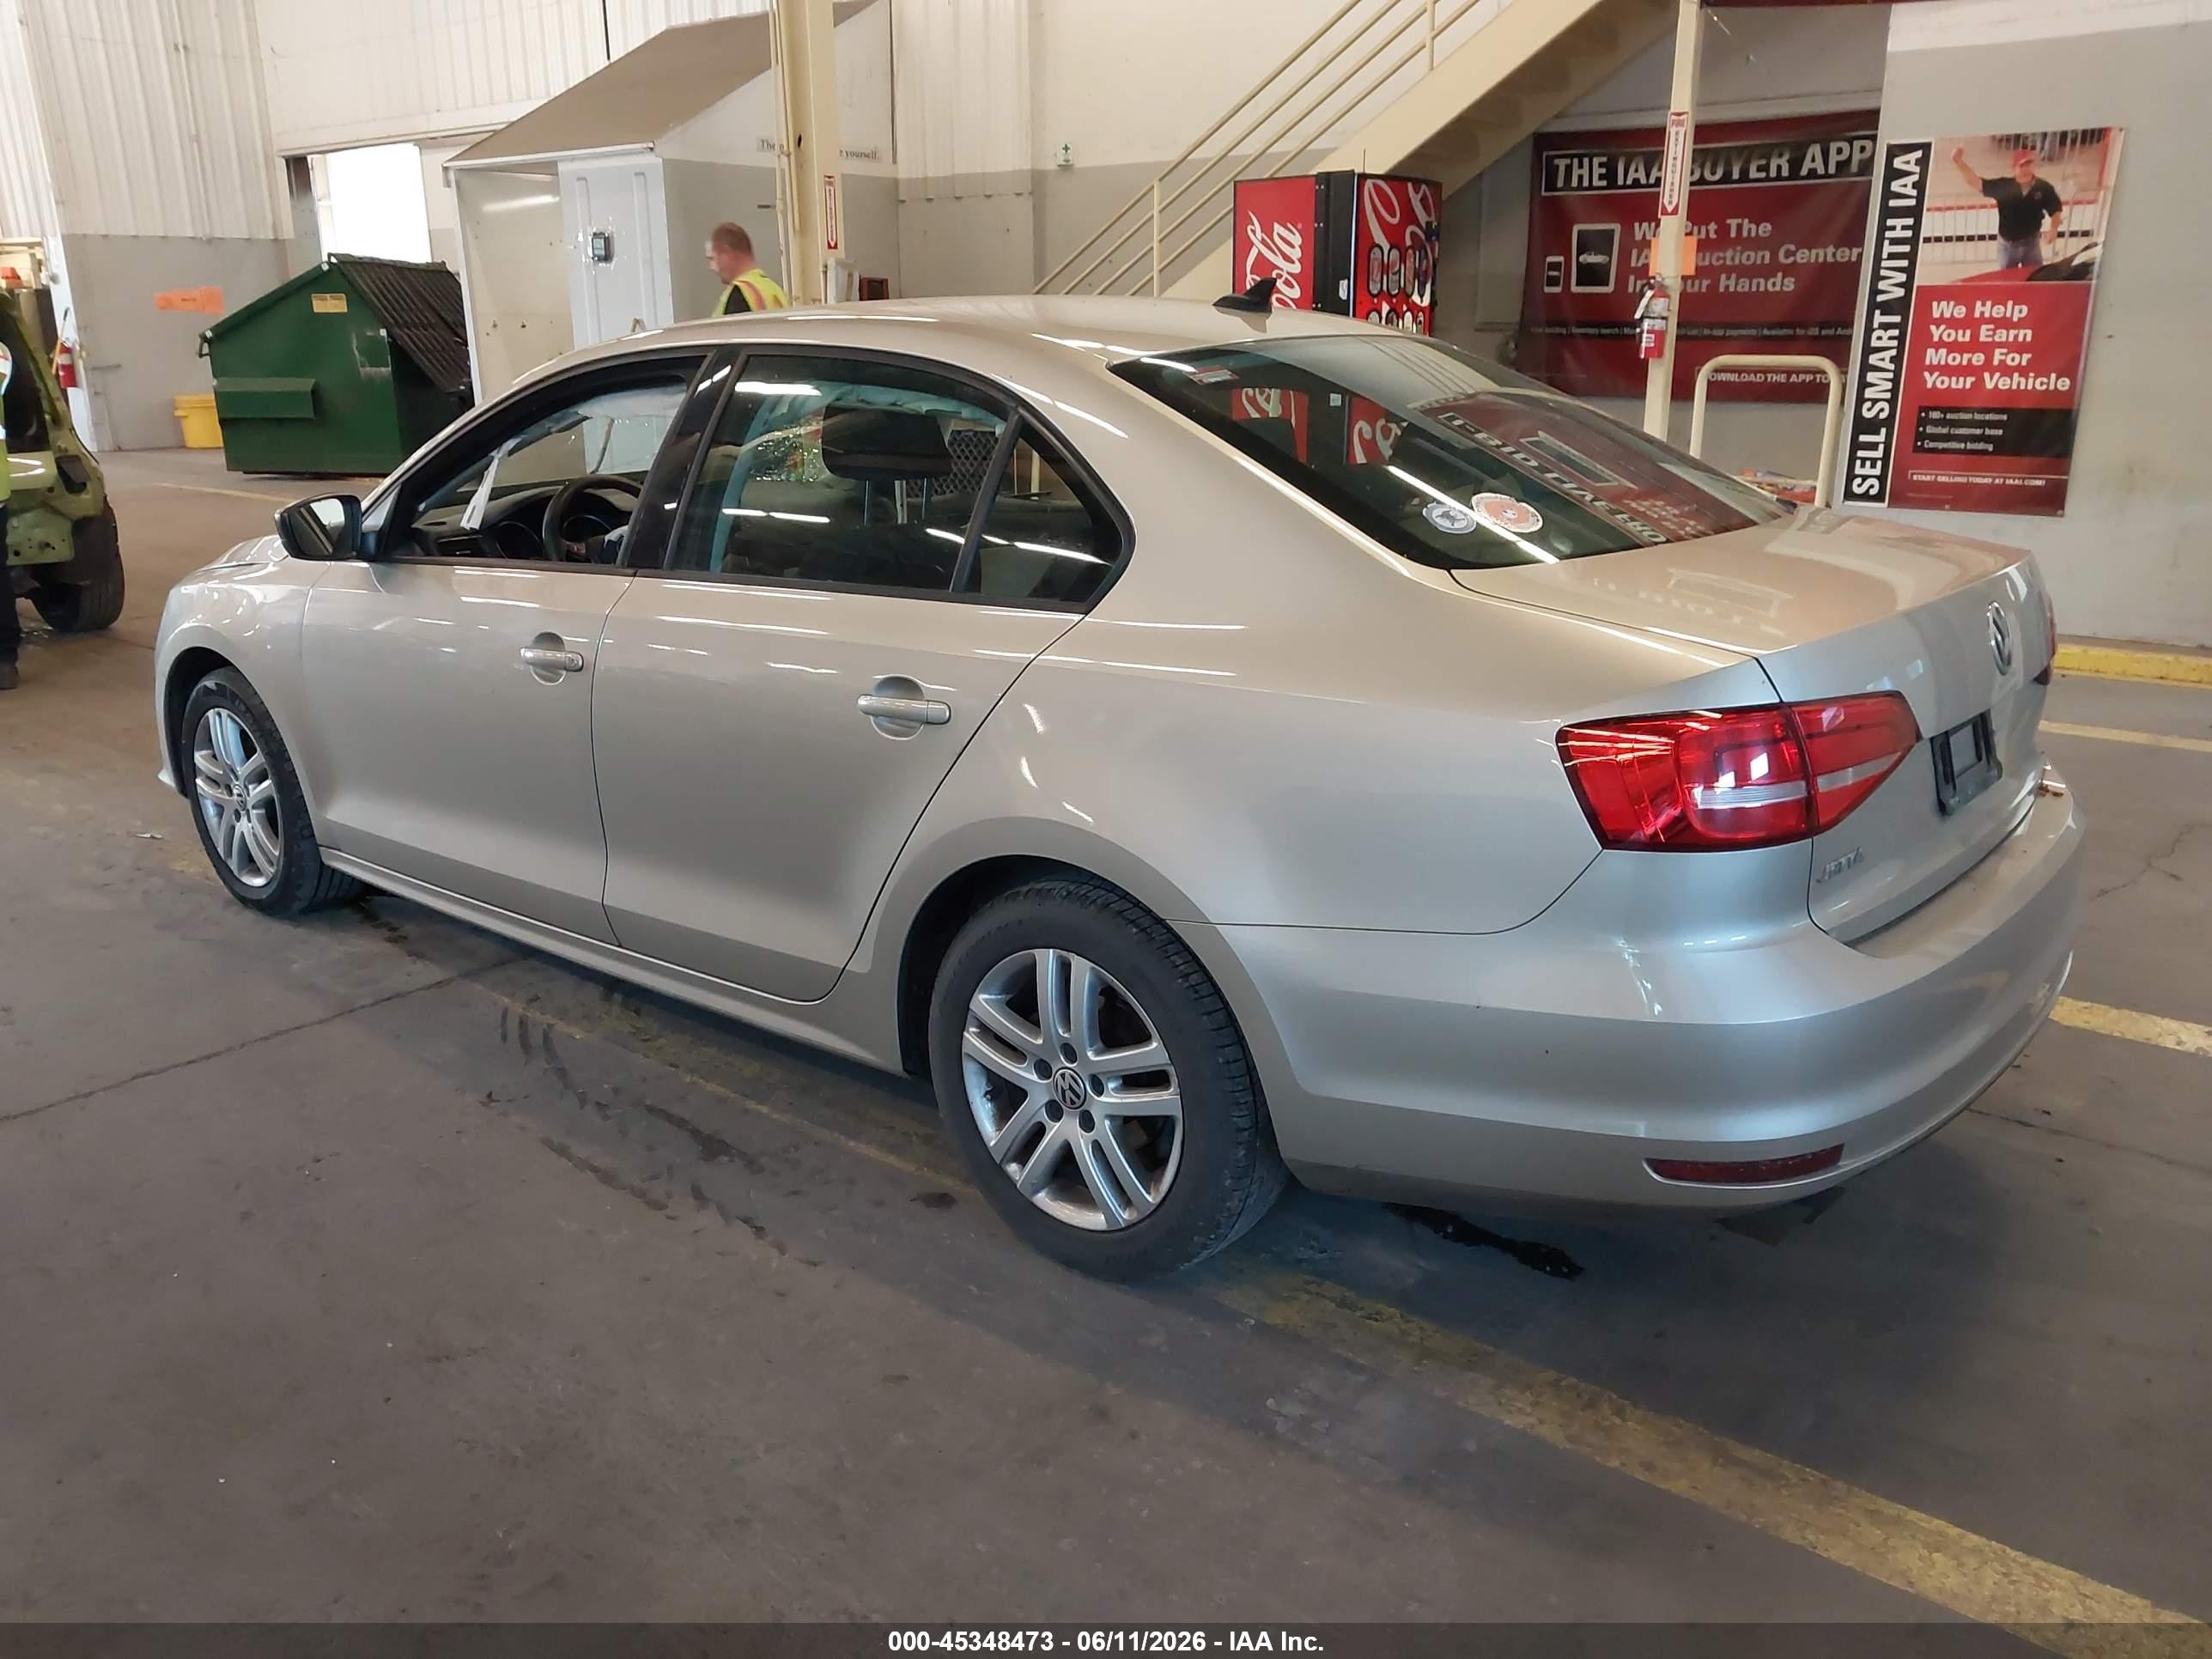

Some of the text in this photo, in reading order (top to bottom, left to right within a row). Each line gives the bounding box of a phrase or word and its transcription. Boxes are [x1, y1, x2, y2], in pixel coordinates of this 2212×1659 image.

[1553, 156, 1607, 188] THE
[1800, 139, 1874, 177] APP
[1726, 218, 1772, 239] The
[1630, 244, 1863, 267] IA uction Center
[1680, 279, 1711, 293] ur
[1718, 272, 1796, 293] Hands
[1932, 300, 2028, 322] We Help
[1852, 149, 1923, 496] SELL SMART WITH IAA
[1929, 324, 2033, 343] You Earn
[1925, 348, 2033, 367] More For
[1708, 372, 1765, 382] OWNLOAD
[1766, 373, 1787, 383] THE
[1789, 373, 1814, 383] APP
[1923, 371, 2071, 391] Your Vehicle
[1973, 411, 2008, 421] locations
